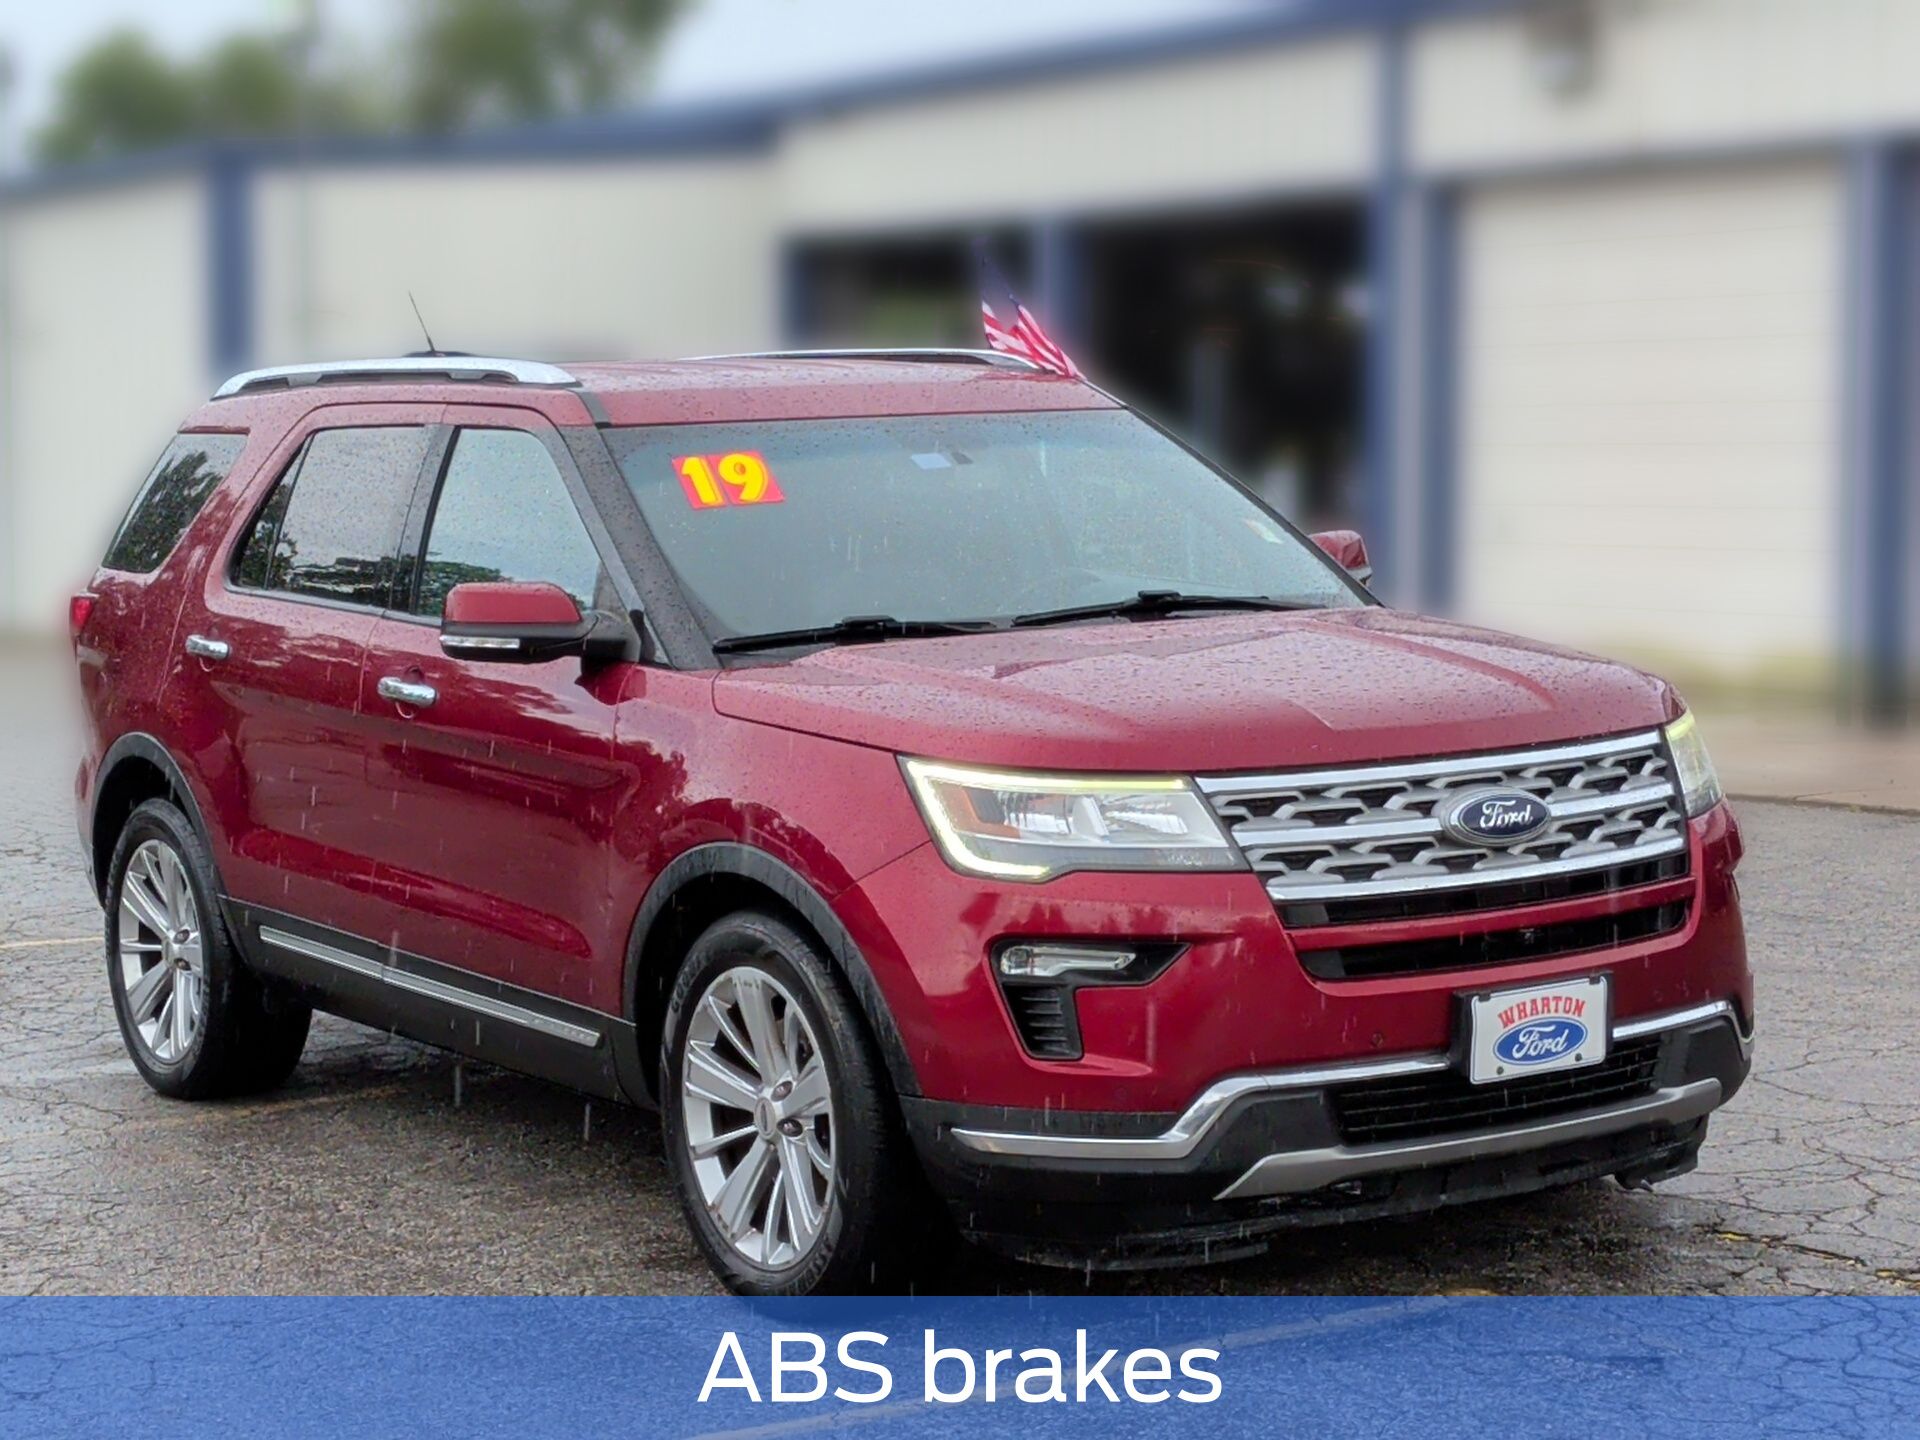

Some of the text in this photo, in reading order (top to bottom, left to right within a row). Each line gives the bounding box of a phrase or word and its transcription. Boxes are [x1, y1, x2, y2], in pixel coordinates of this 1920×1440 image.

[681, 453, 768, 506] 19
[1479, 799, 1533, 829] Ford
[1497, 996, 1586, 1029] WHARTON
[1512, 1024, 1569, 1060] Ford
